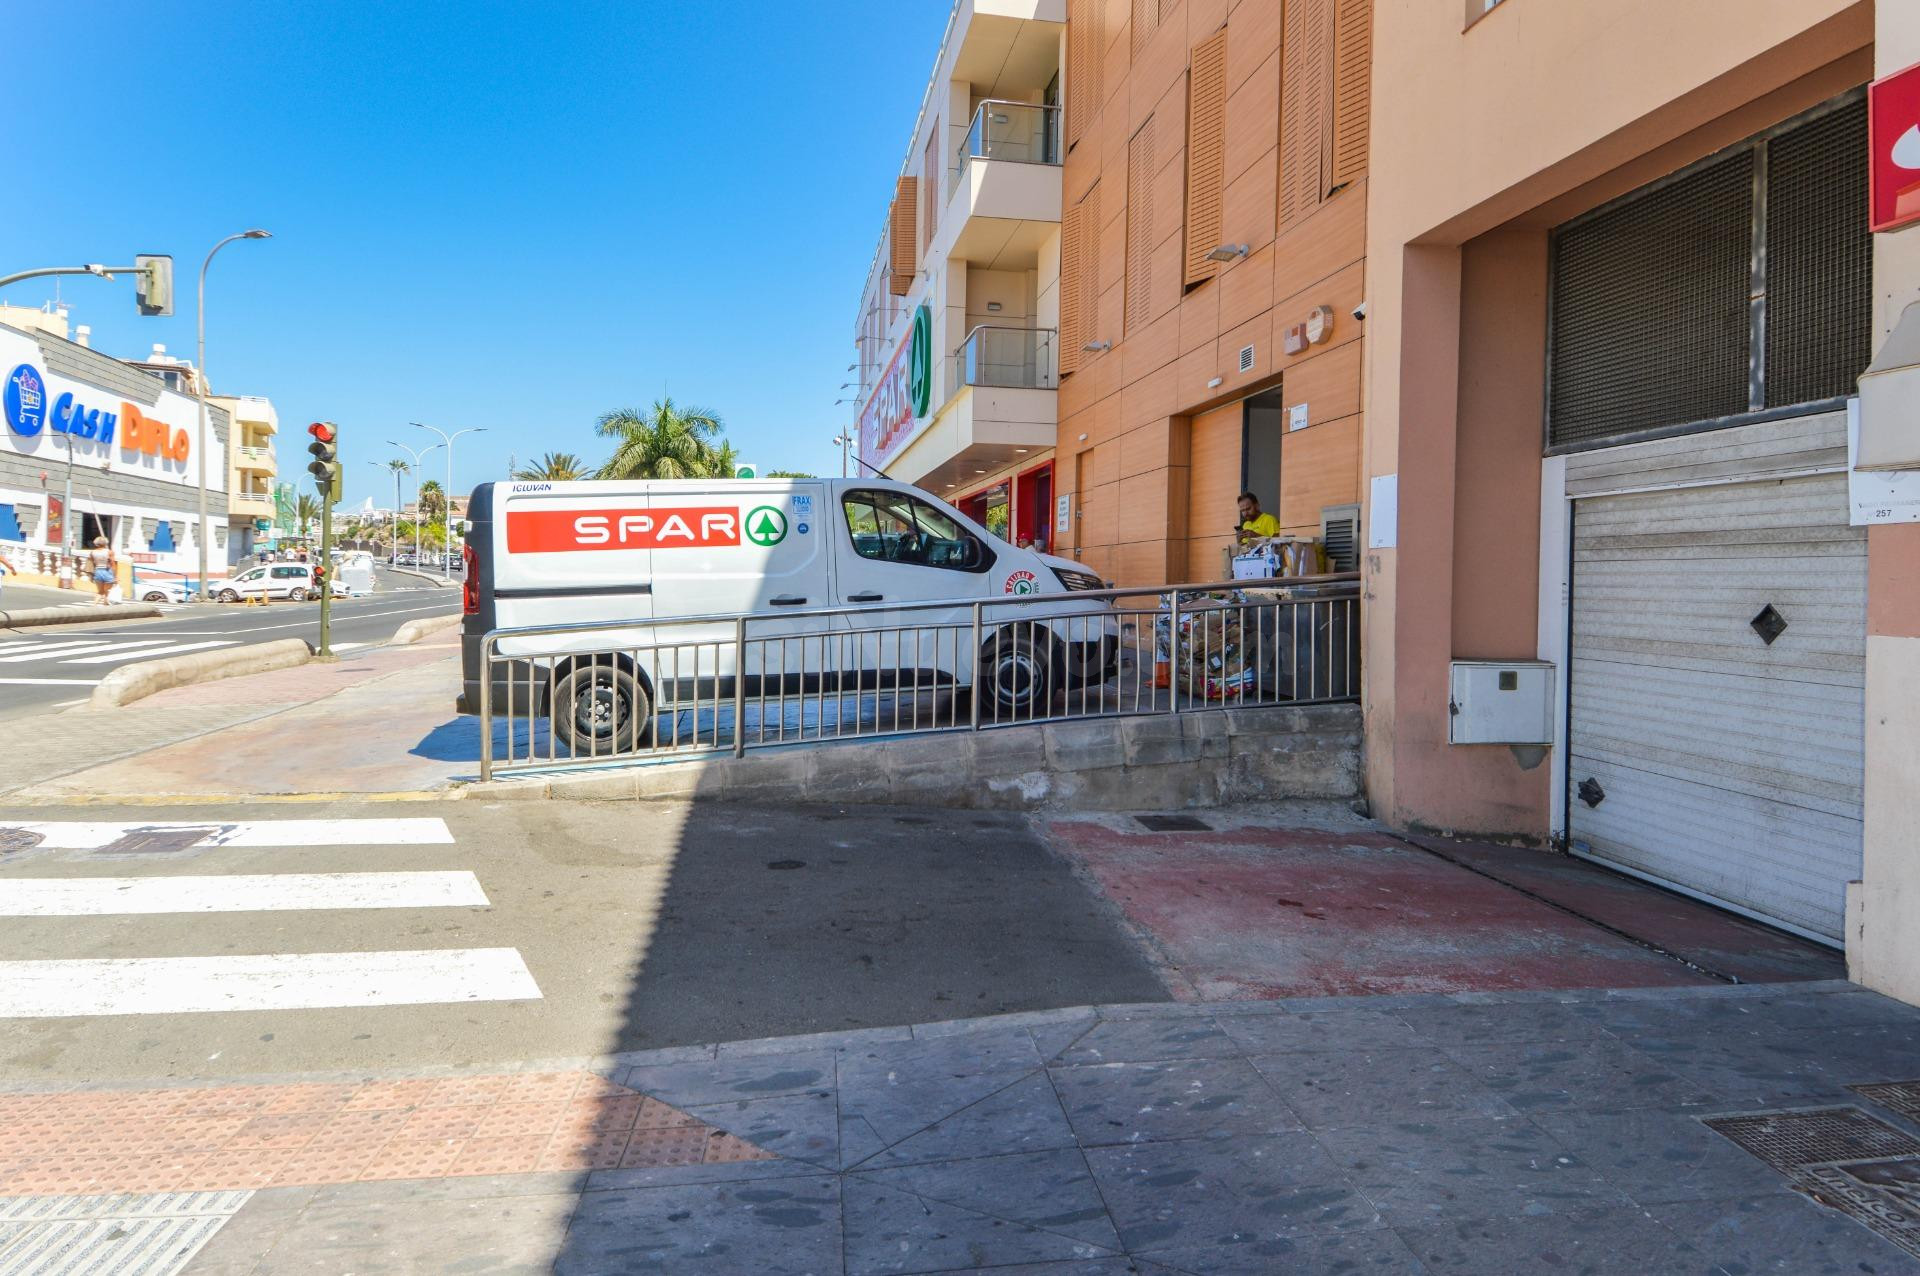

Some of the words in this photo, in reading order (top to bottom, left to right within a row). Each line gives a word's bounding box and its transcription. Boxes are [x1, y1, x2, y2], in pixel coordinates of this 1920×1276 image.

[50, 392, 117, 444] CASH
[120, 402, 190, 462] DIPLO
[512, 484, 552, 493] IGLUVAN
[1875, 509, 1892, 518] 257
[574, 513, 736, 544] SPAR
[1006, 571, 1031, 590] CALIDAD
[1811, 1166, 1906, 1223] Unelco
